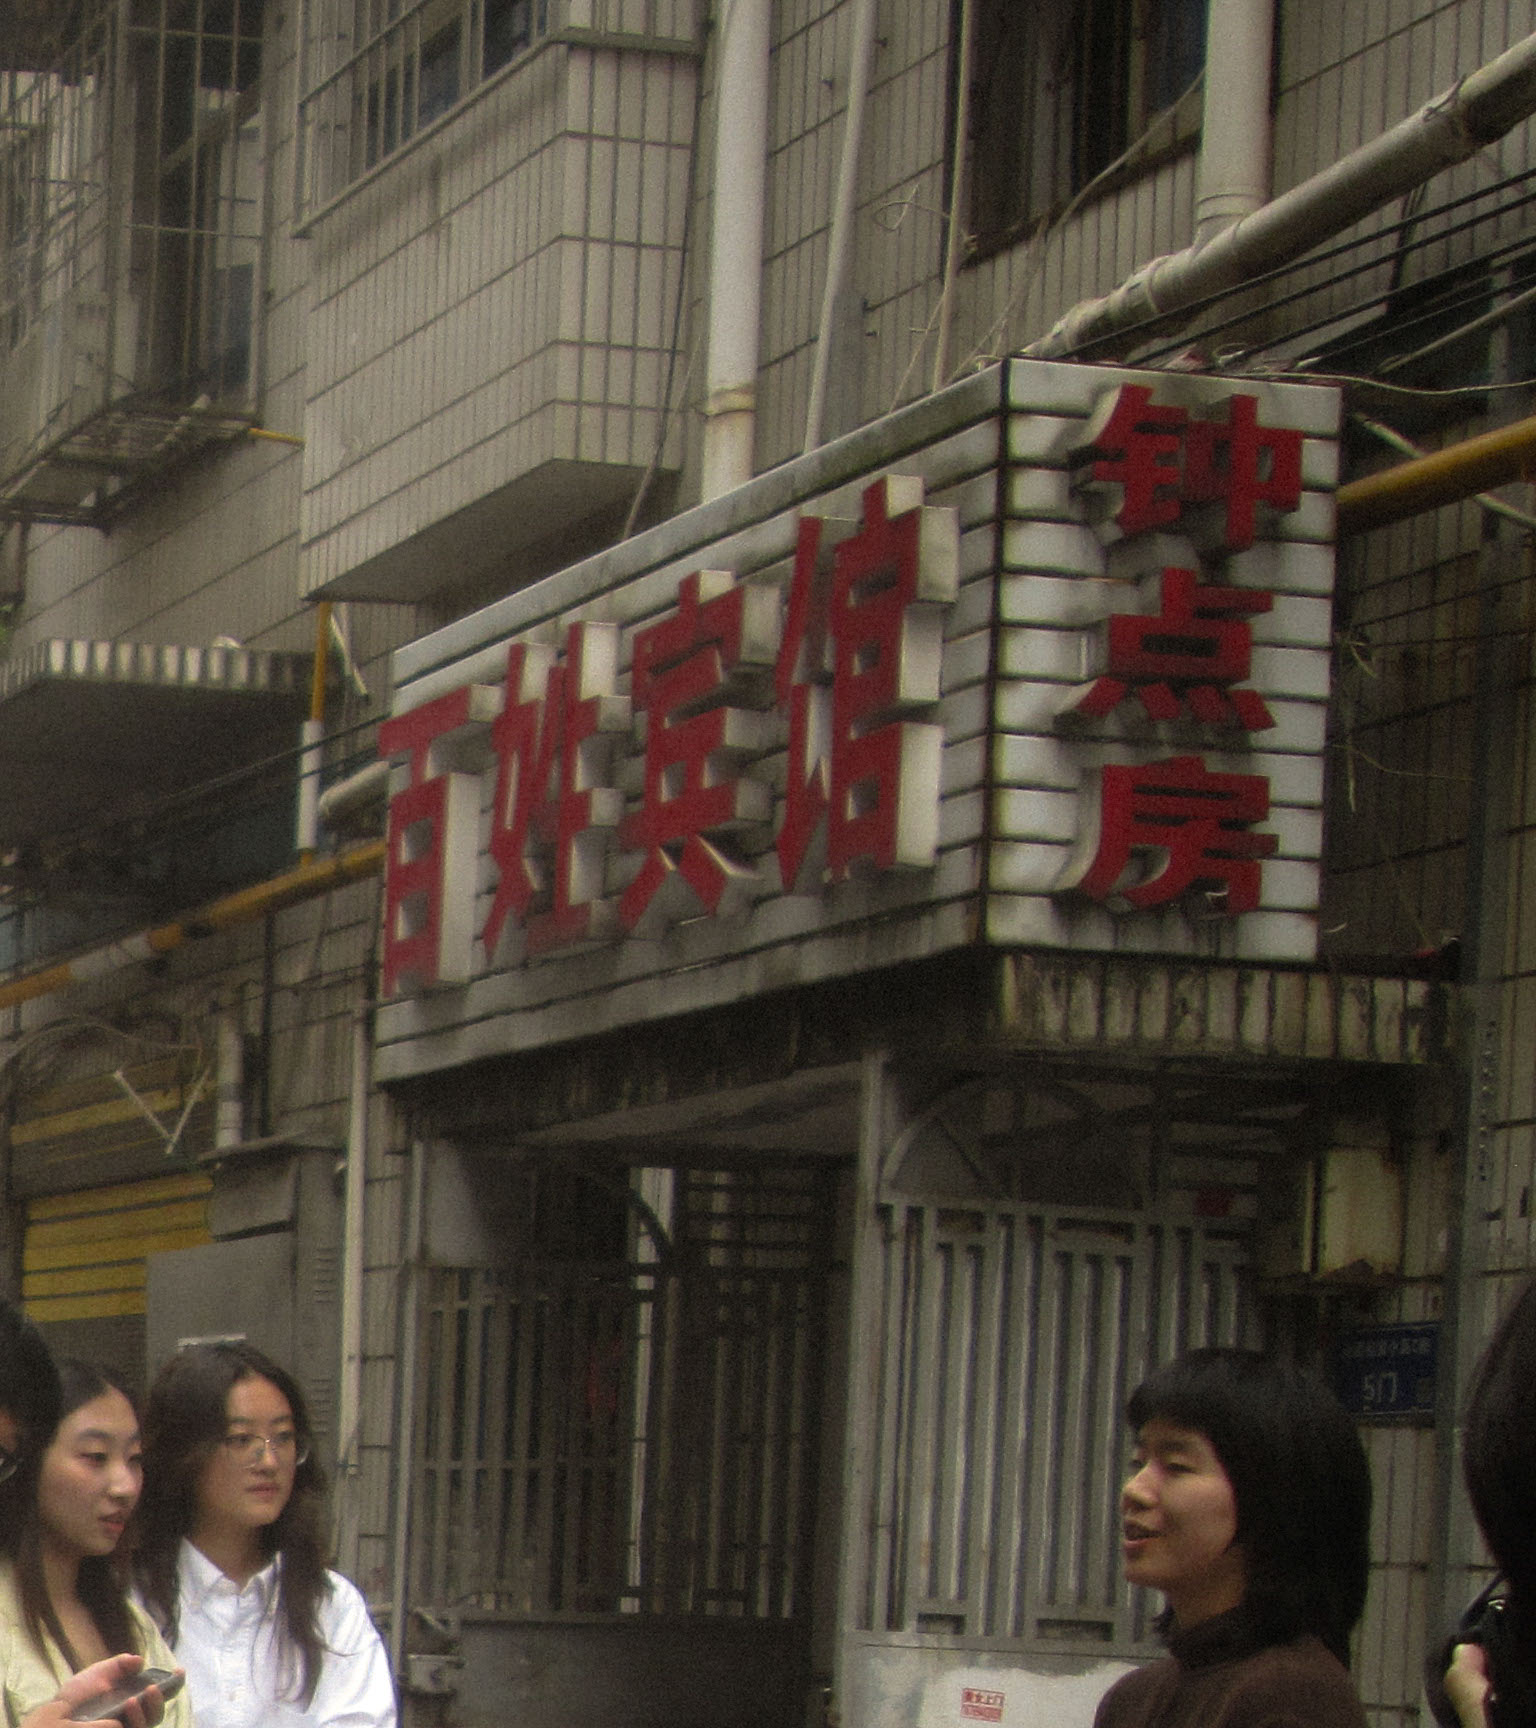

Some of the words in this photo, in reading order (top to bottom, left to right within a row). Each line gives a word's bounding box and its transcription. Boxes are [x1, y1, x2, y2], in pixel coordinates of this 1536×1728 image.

[379, 475, 946, 998] 百姓宾馆
[1074, 383, 1304, 914] 钟点房
